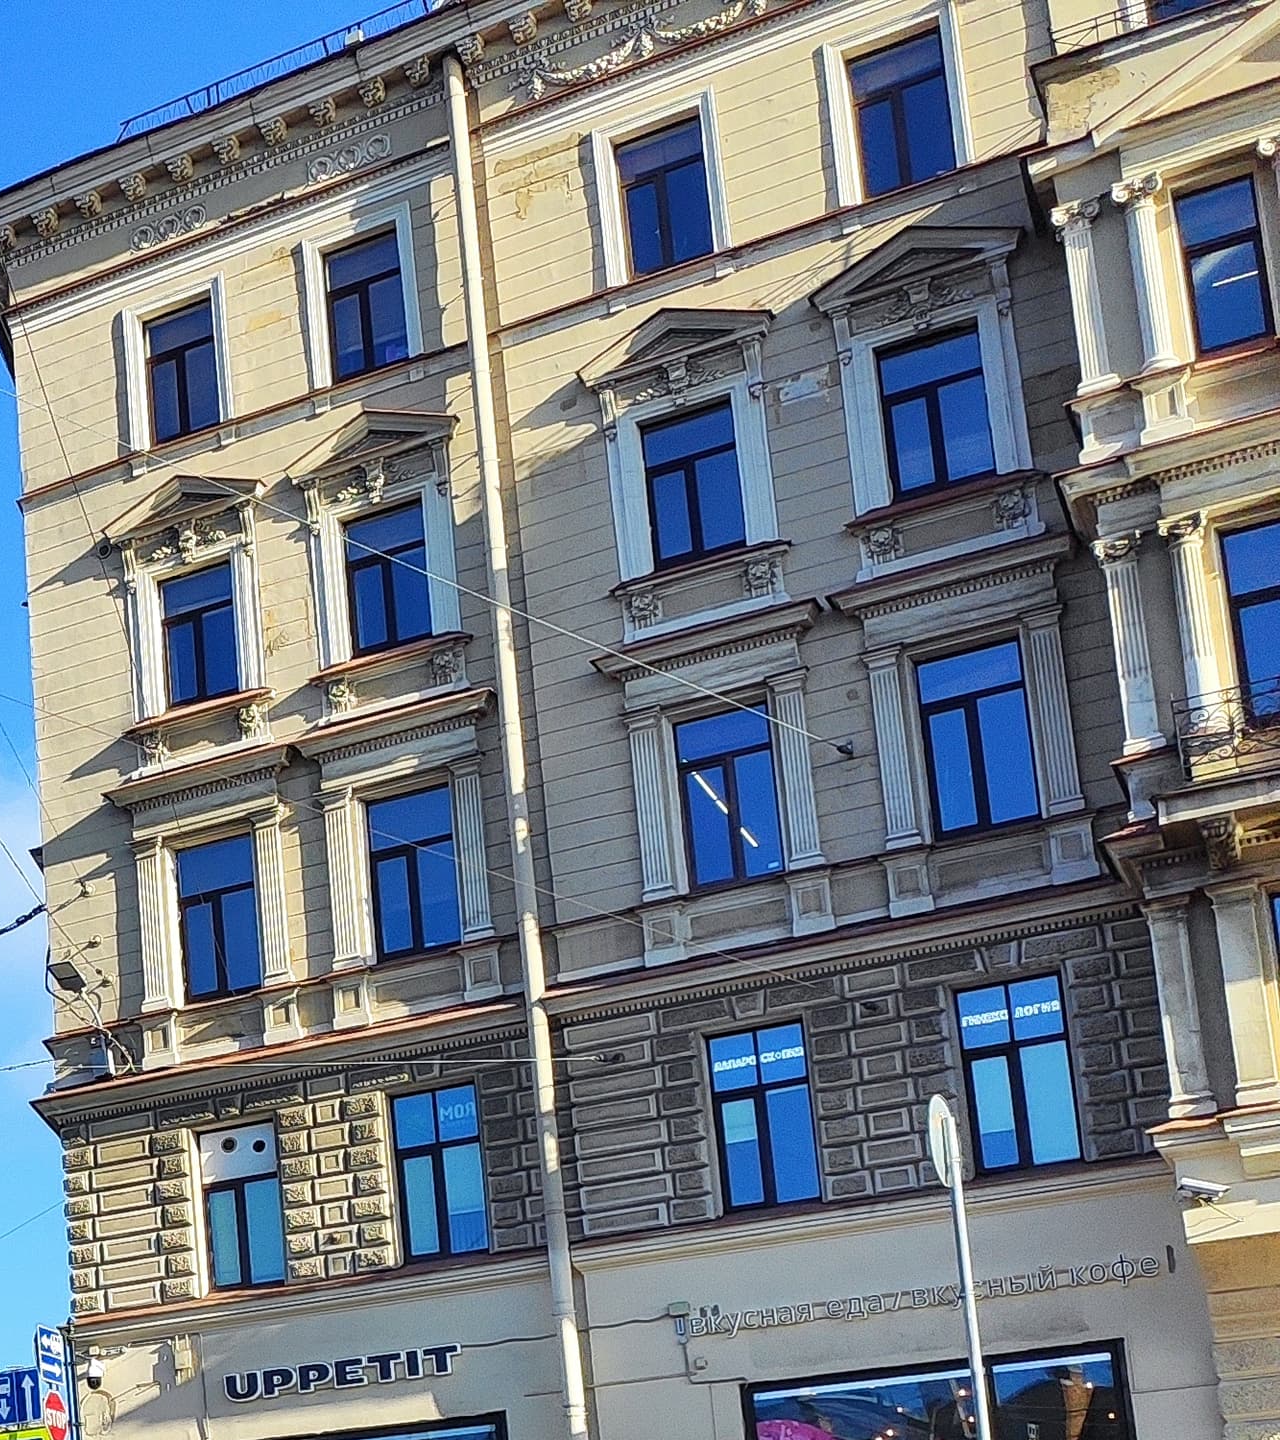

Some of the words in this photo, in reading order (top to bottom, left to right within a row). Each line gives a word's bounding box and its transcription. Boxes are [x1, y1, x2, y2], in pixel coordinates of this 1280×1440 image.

[690, 1301, 814, 1339] вкусная
[826, 1293, 886, 1322] еда
[1069, 1252, 1160, 1287] кофе
[224, 1343, 462, 1402] UPPETIT
[46, 1408, 67, 1430] STOP
